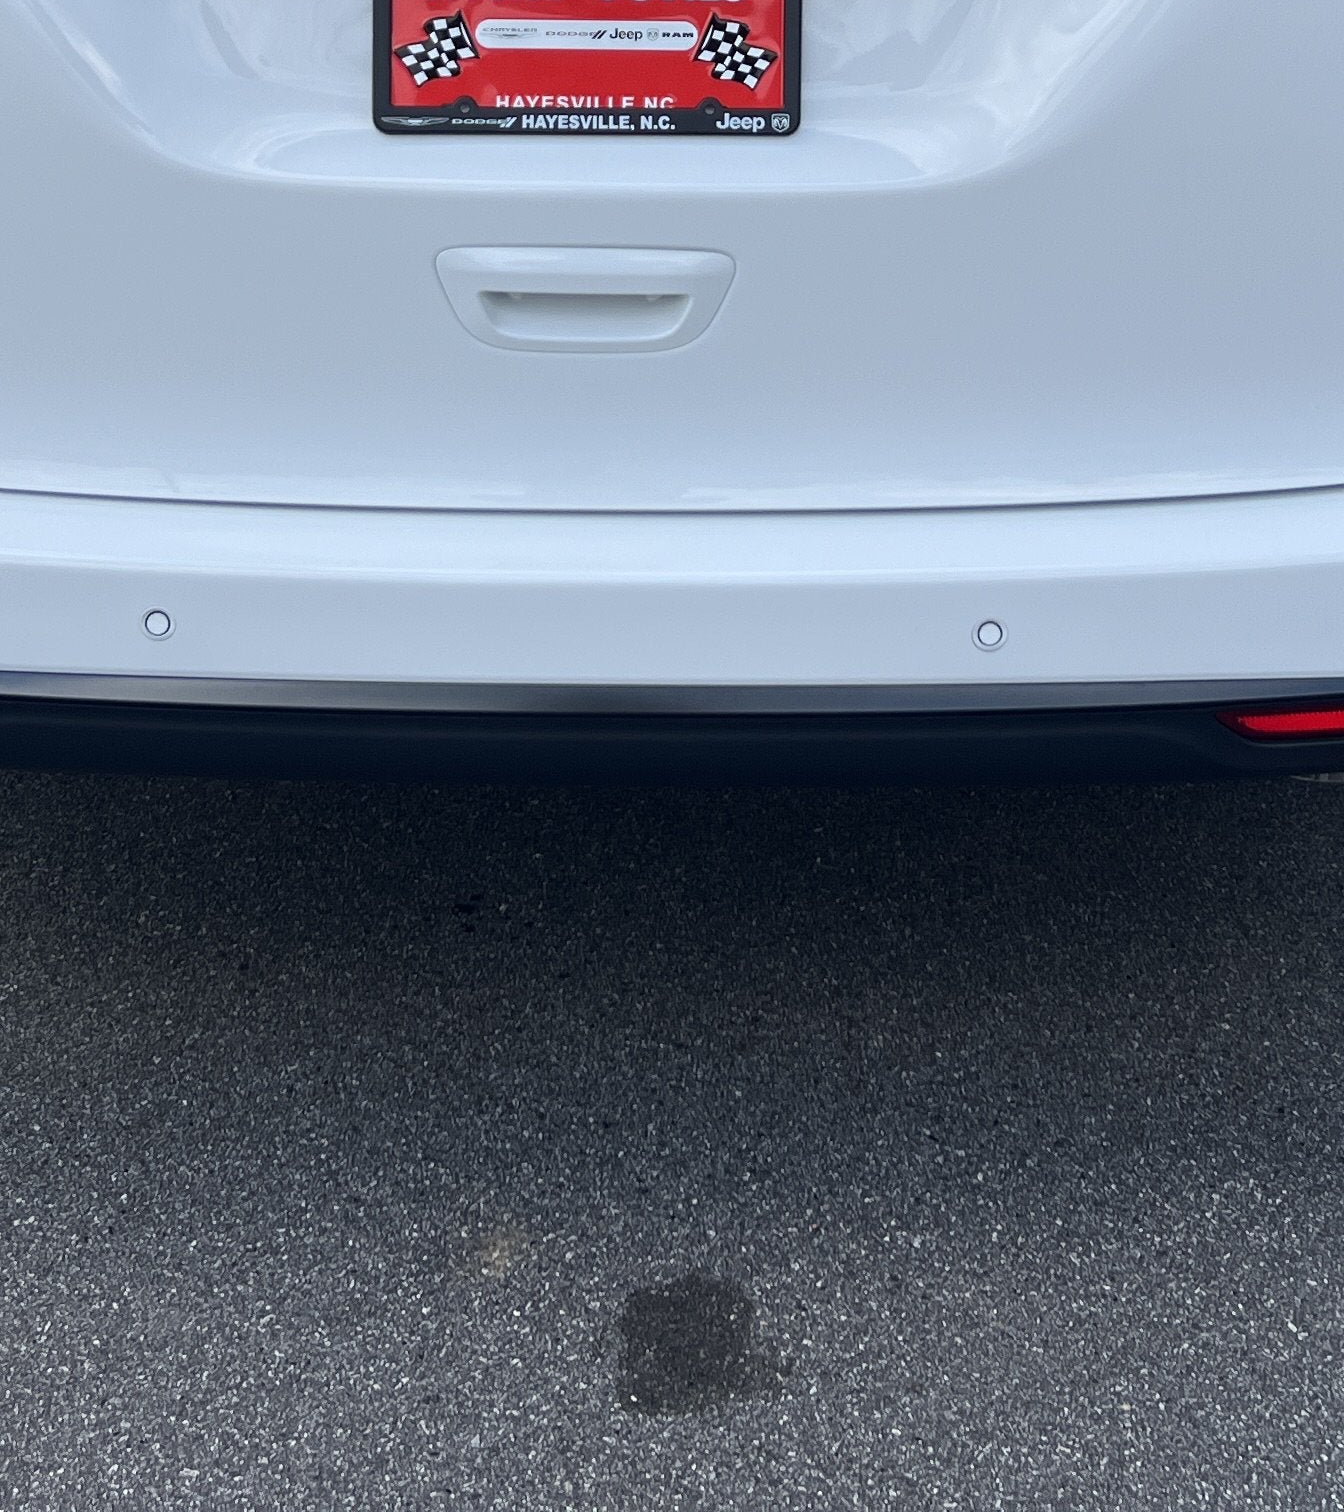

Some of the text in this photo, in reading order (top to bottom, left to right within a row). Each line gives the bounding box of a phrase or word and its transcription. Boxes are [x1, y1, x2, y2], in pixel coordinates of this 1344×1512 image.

[609, 28, 643, 42] Jeep
[522, 114, 635, 131] HAYESVILLE,
[640, 115, 676, 130] N.C.
[716, 113, 766, 132] Jeep
